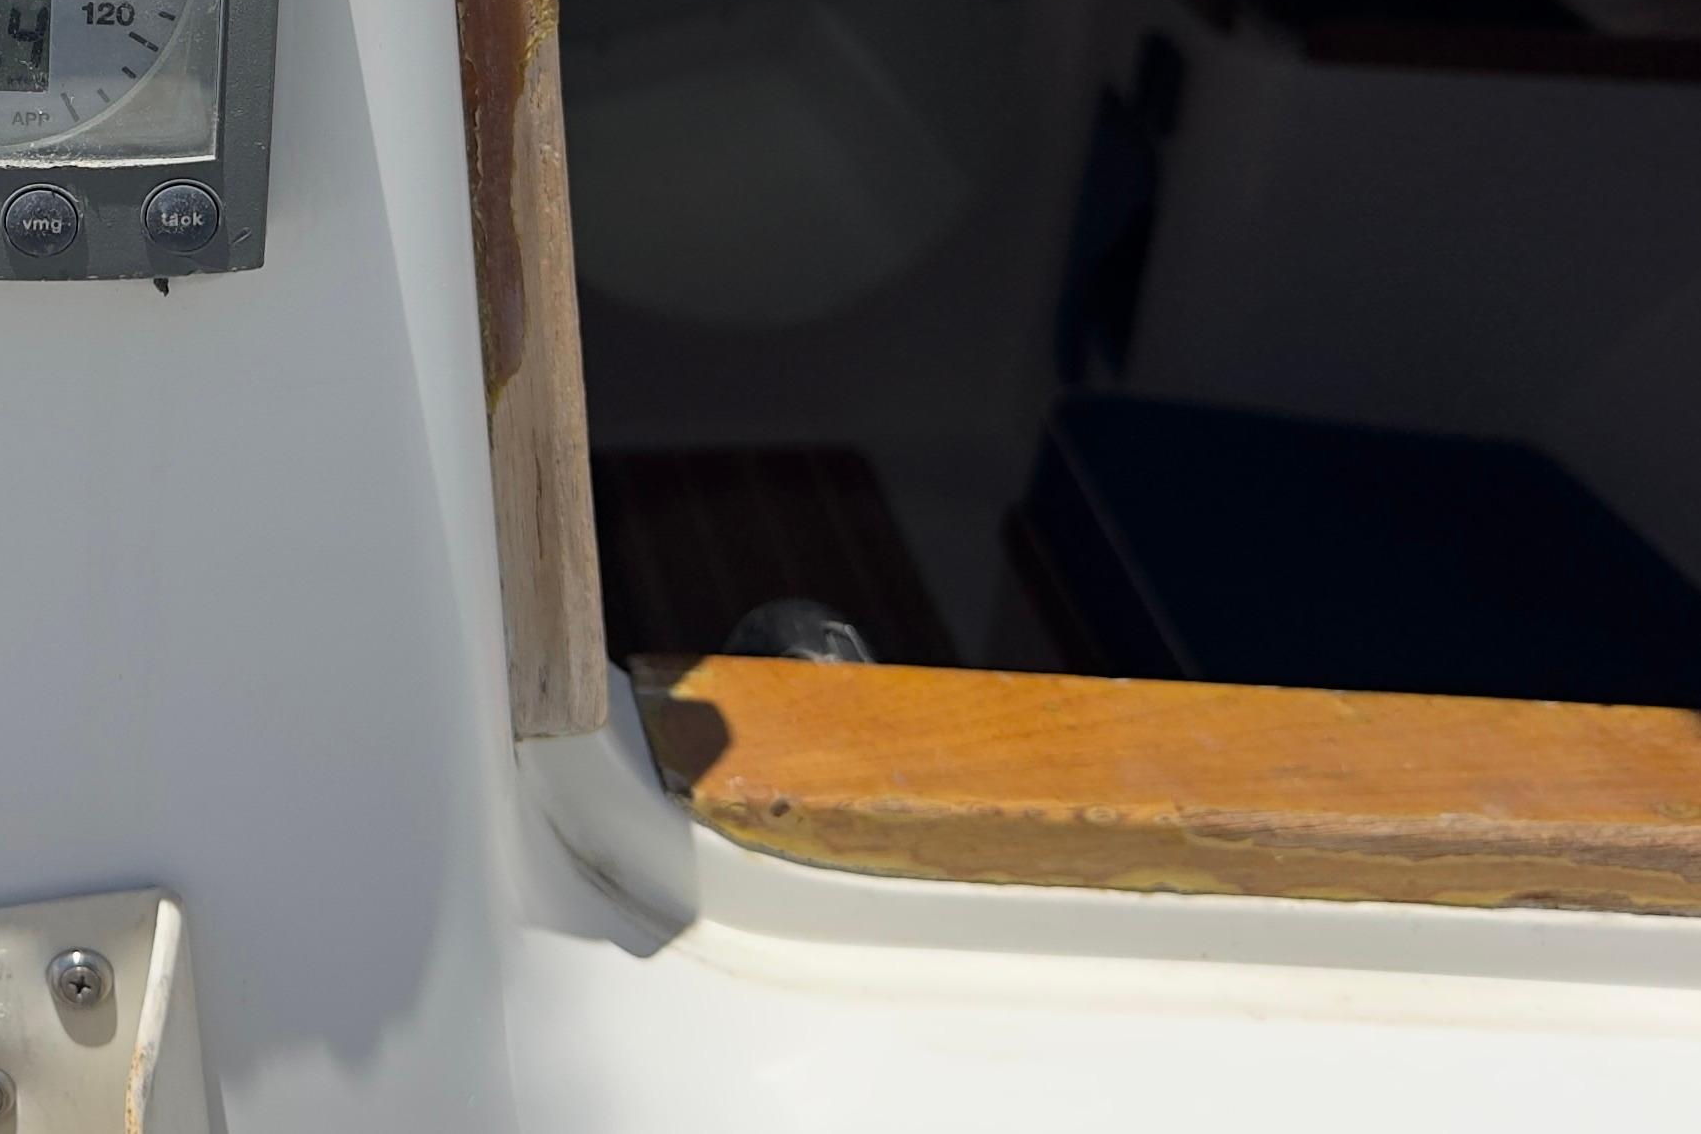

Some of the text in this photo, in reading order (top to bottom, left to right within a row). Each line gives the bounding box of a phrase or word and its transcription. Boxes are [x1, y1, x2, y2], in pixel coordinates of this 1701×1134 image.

[81, 2, 137, 27] 120
[11, 111, 51, 127] APP
[22, 218, 63, 235] vmg
